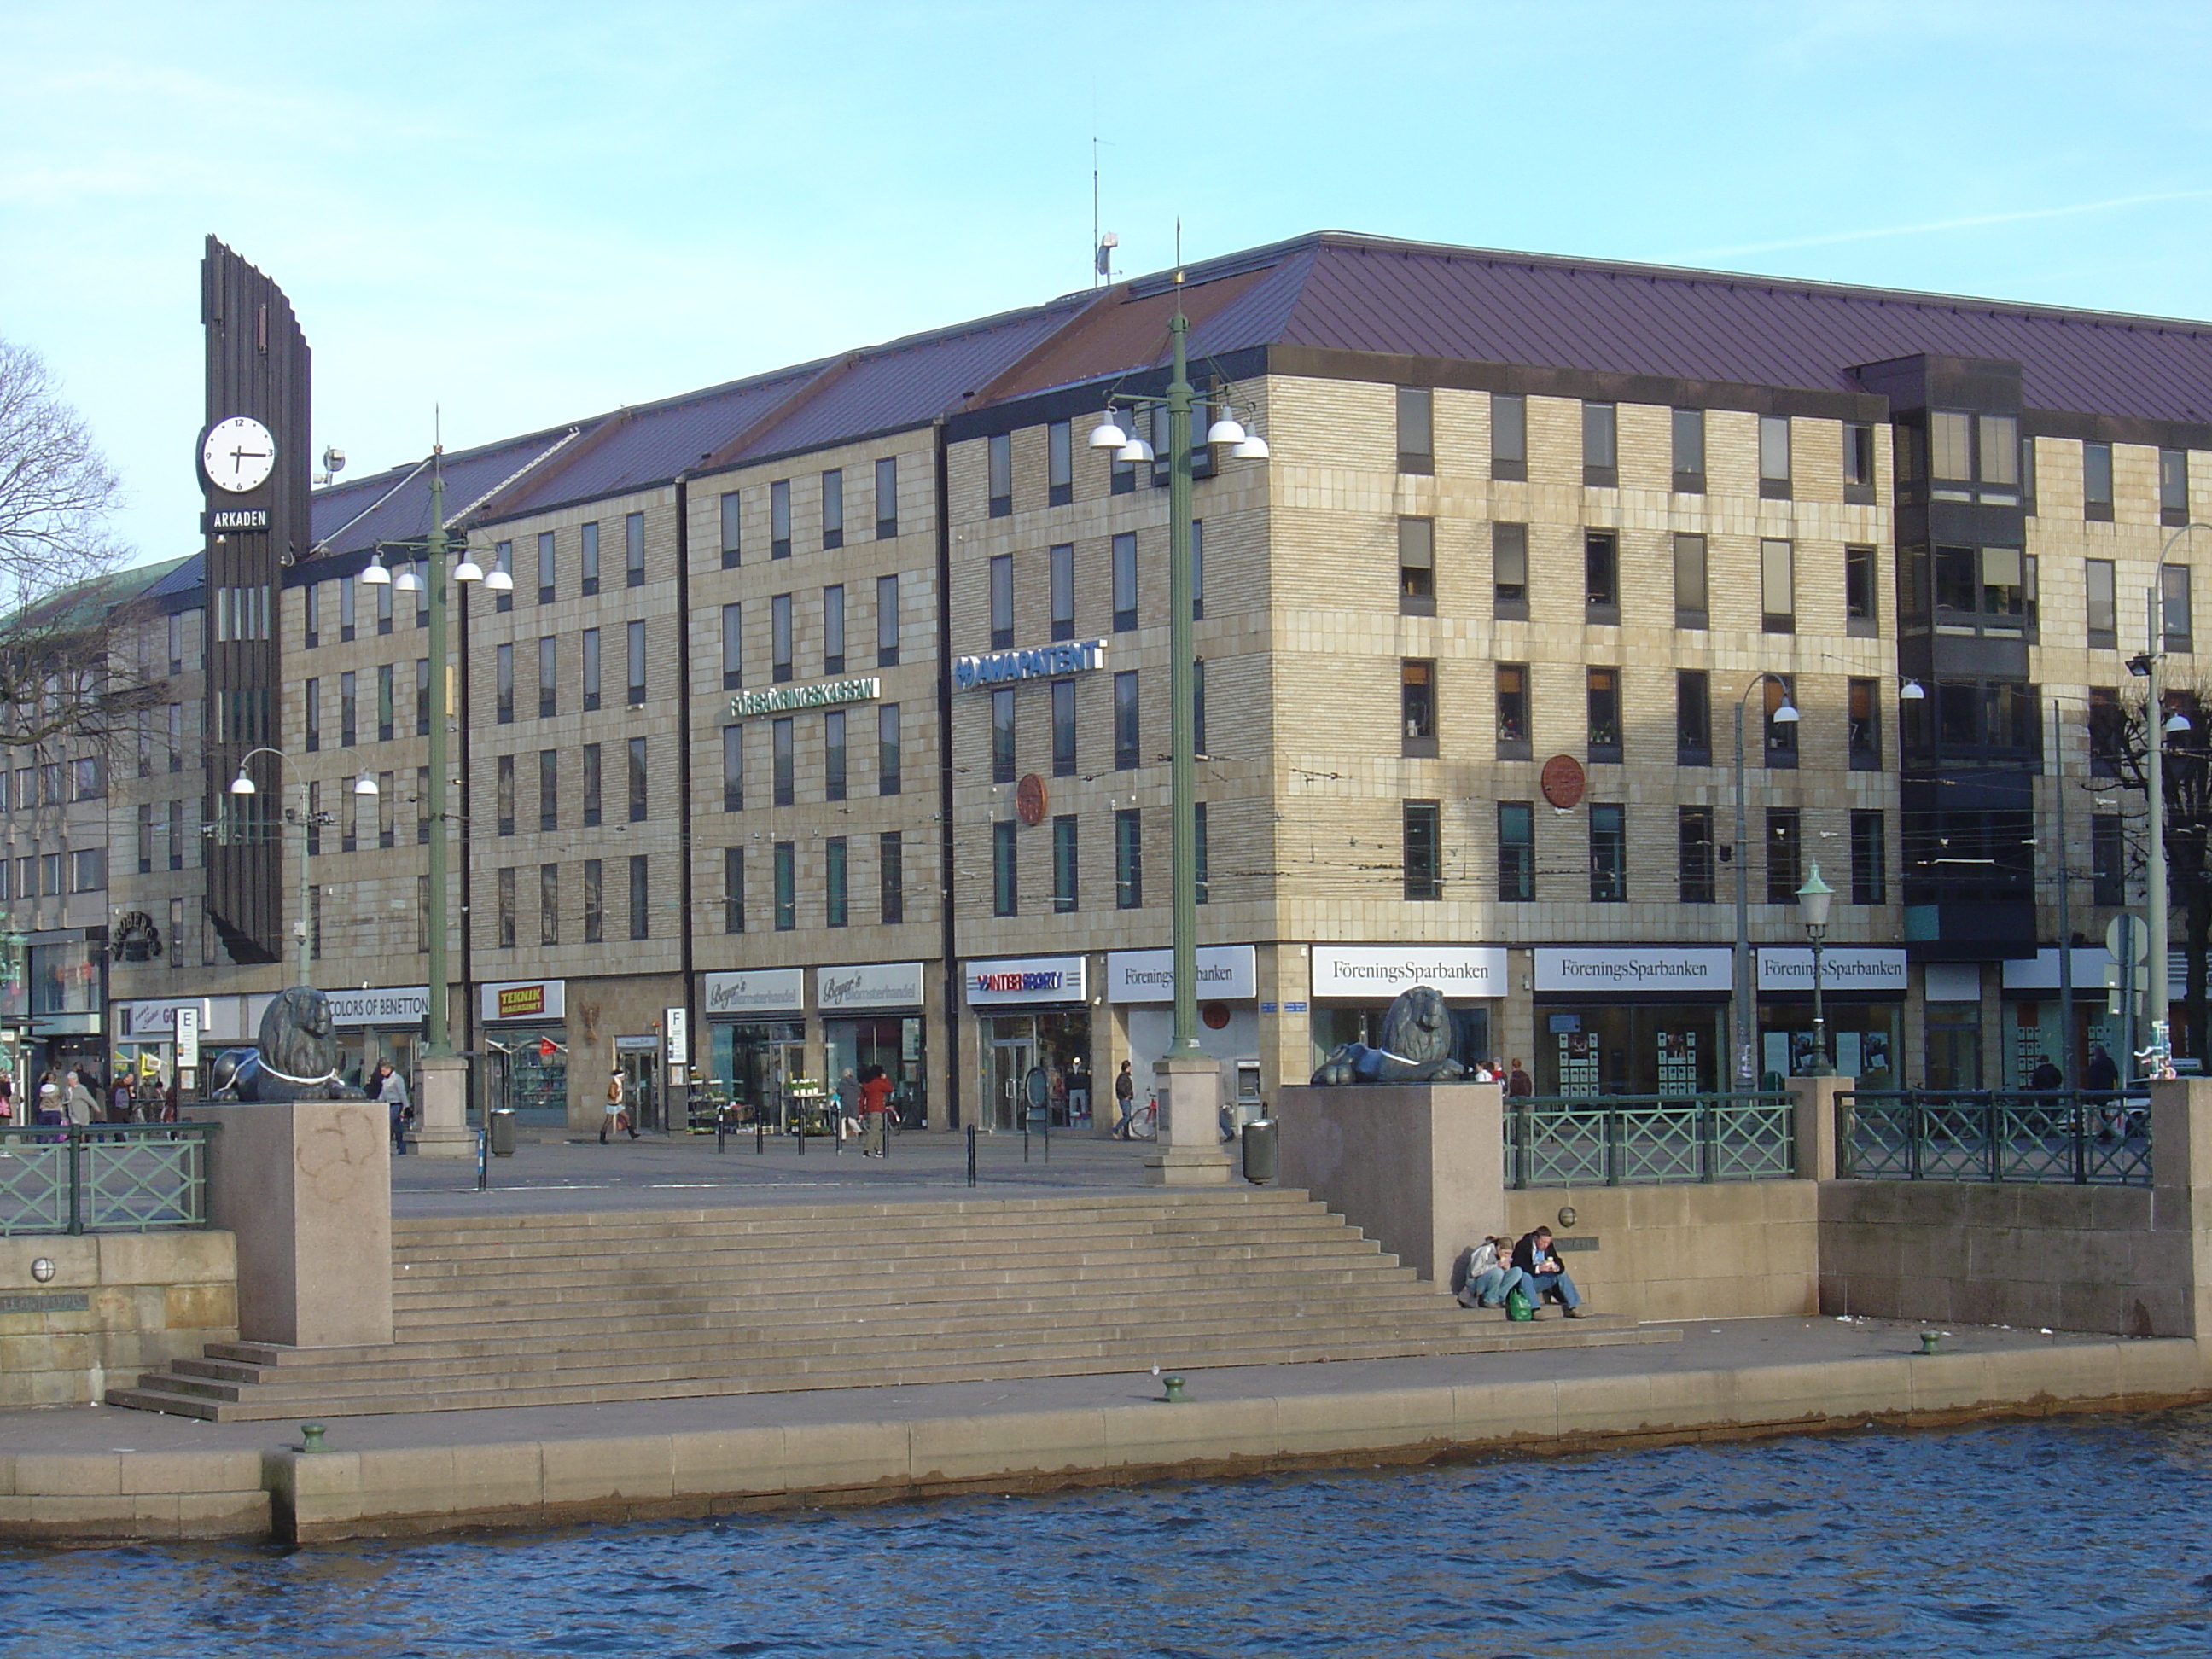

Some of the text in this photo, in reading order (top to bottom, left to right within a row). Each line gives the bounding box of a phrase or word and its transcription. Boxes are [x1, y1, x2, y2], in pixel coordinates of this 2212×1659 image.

[235, 418, 244, 427] 12
[206, 451, 212, 460] 9
[267, 448, 274, 457] 3
[236, 482, 243, 491] 6
[213, 510, 266, 527] ARKADEN
[976, 639, 1107, 684] AWAPATENT
[1333, 960, 1489, 983] FöreningsSparbanken
[1561, 958, 1708, 981] FöreningsSparbanken
[1764, 959, 1902, 981] FöreninsSparbanken
[501, 988, 541, 1005] TEKNIK
[329, 996, 428, 1017] COLORS OF BENETTON
[183, 1012, 192, 1027] E
[672, 1011, 680, 1026] F
